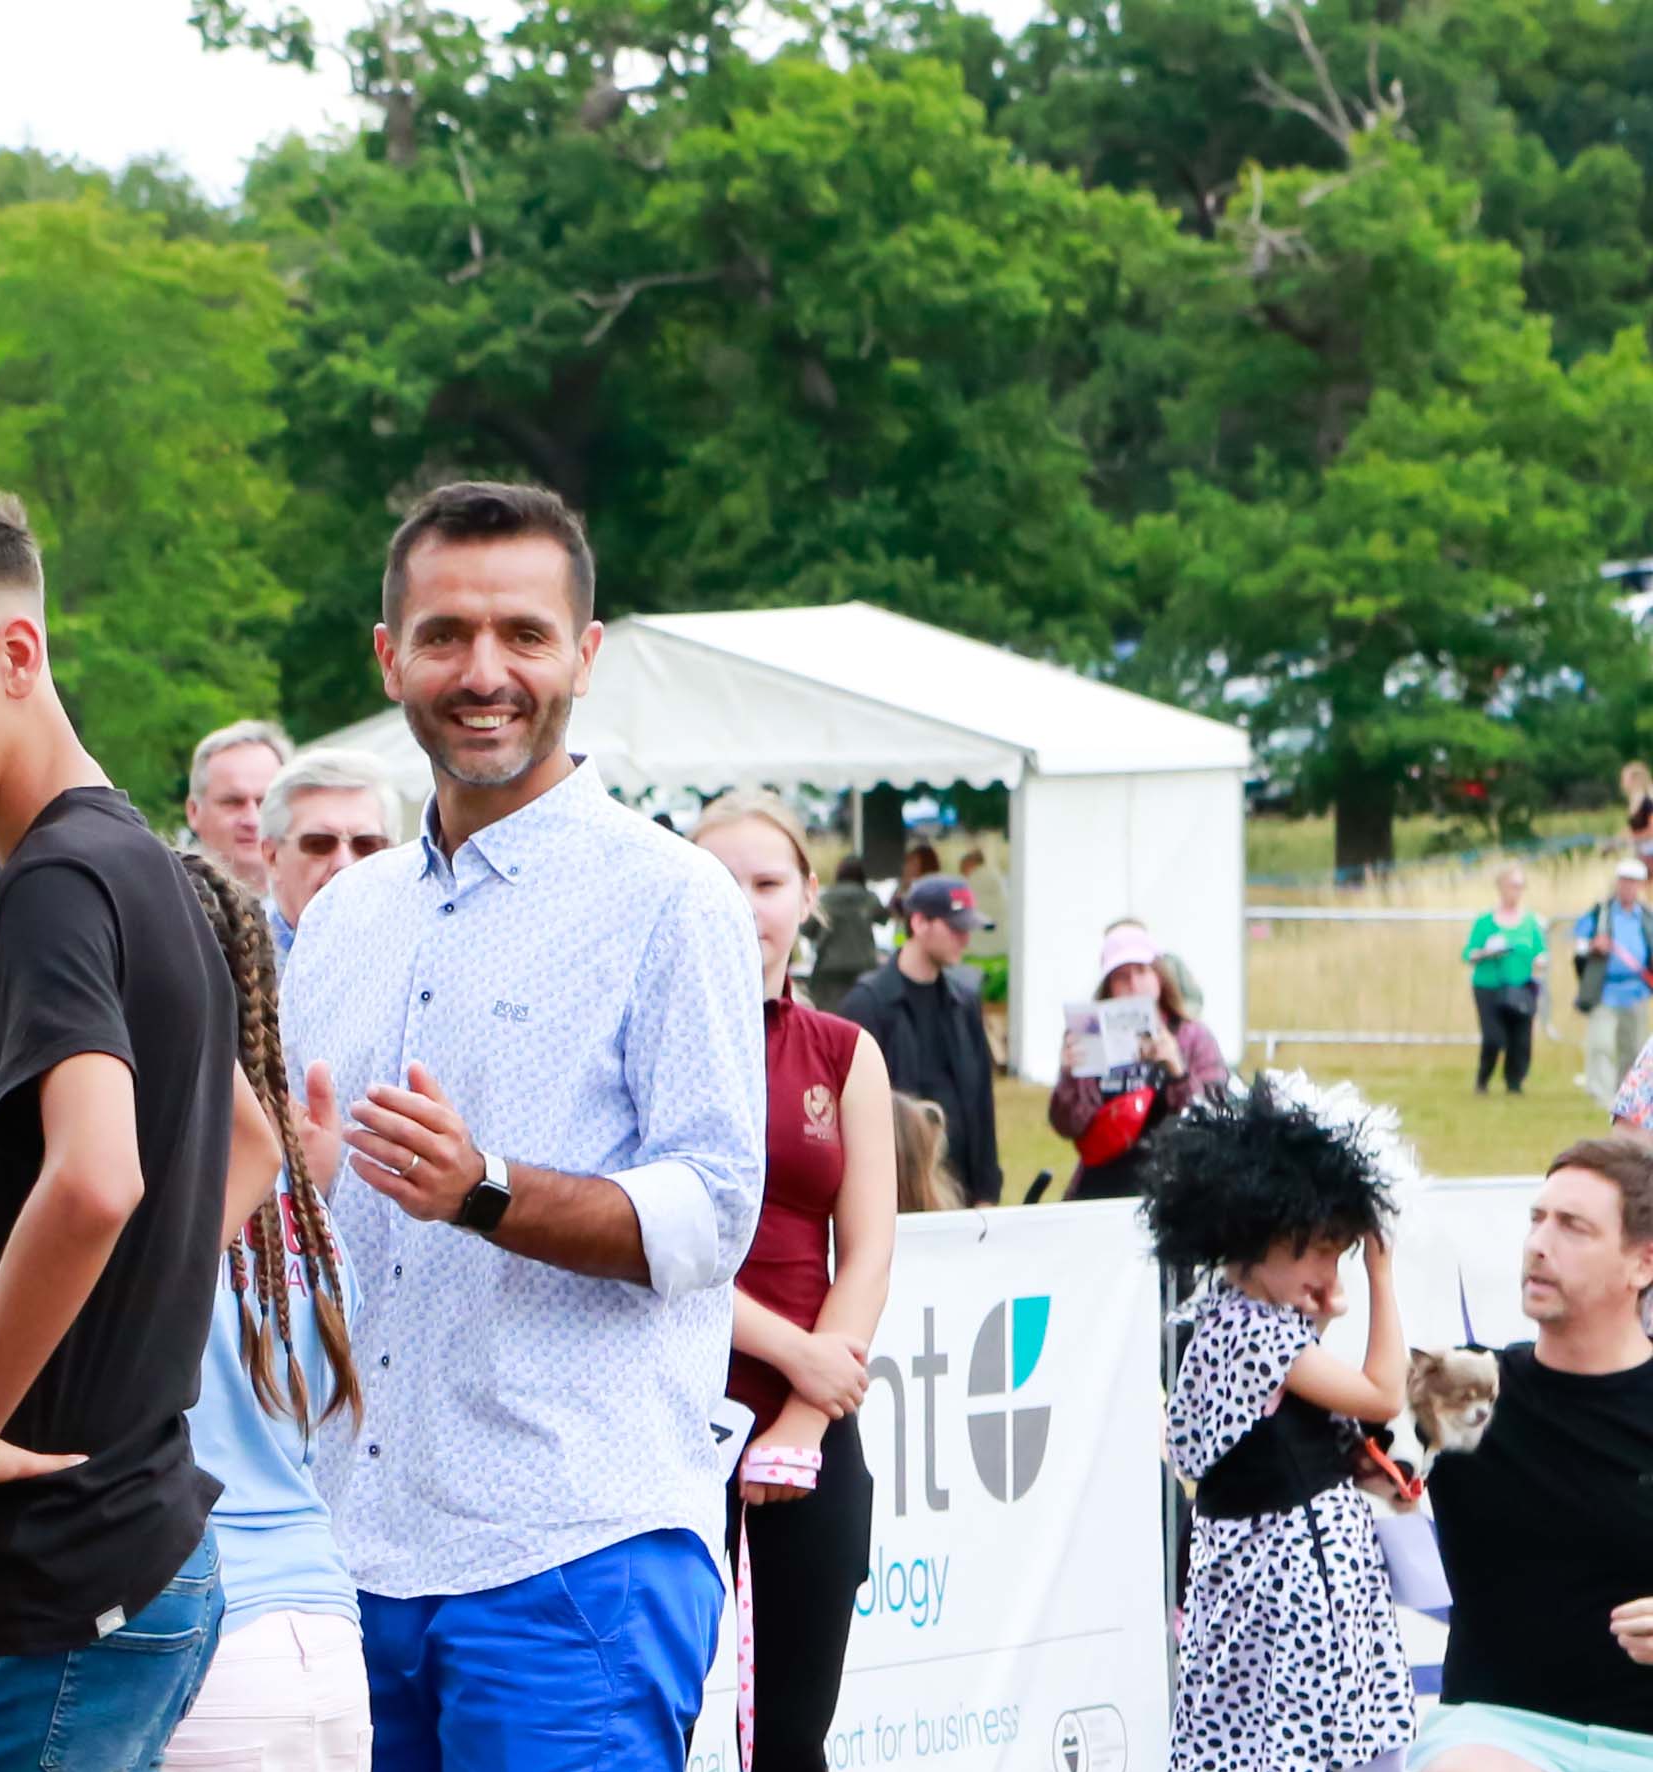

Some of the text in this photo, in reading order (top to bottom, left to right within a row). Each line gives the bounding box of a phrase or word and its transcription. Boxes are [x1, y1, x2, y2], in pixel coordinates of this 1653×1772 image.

[866, 1306, 950, 1517] nt
[855, 1545, 950, 1628] ology
[874, 1714, 907, 1763] for
[914, 1702, 1020, 1756] business
